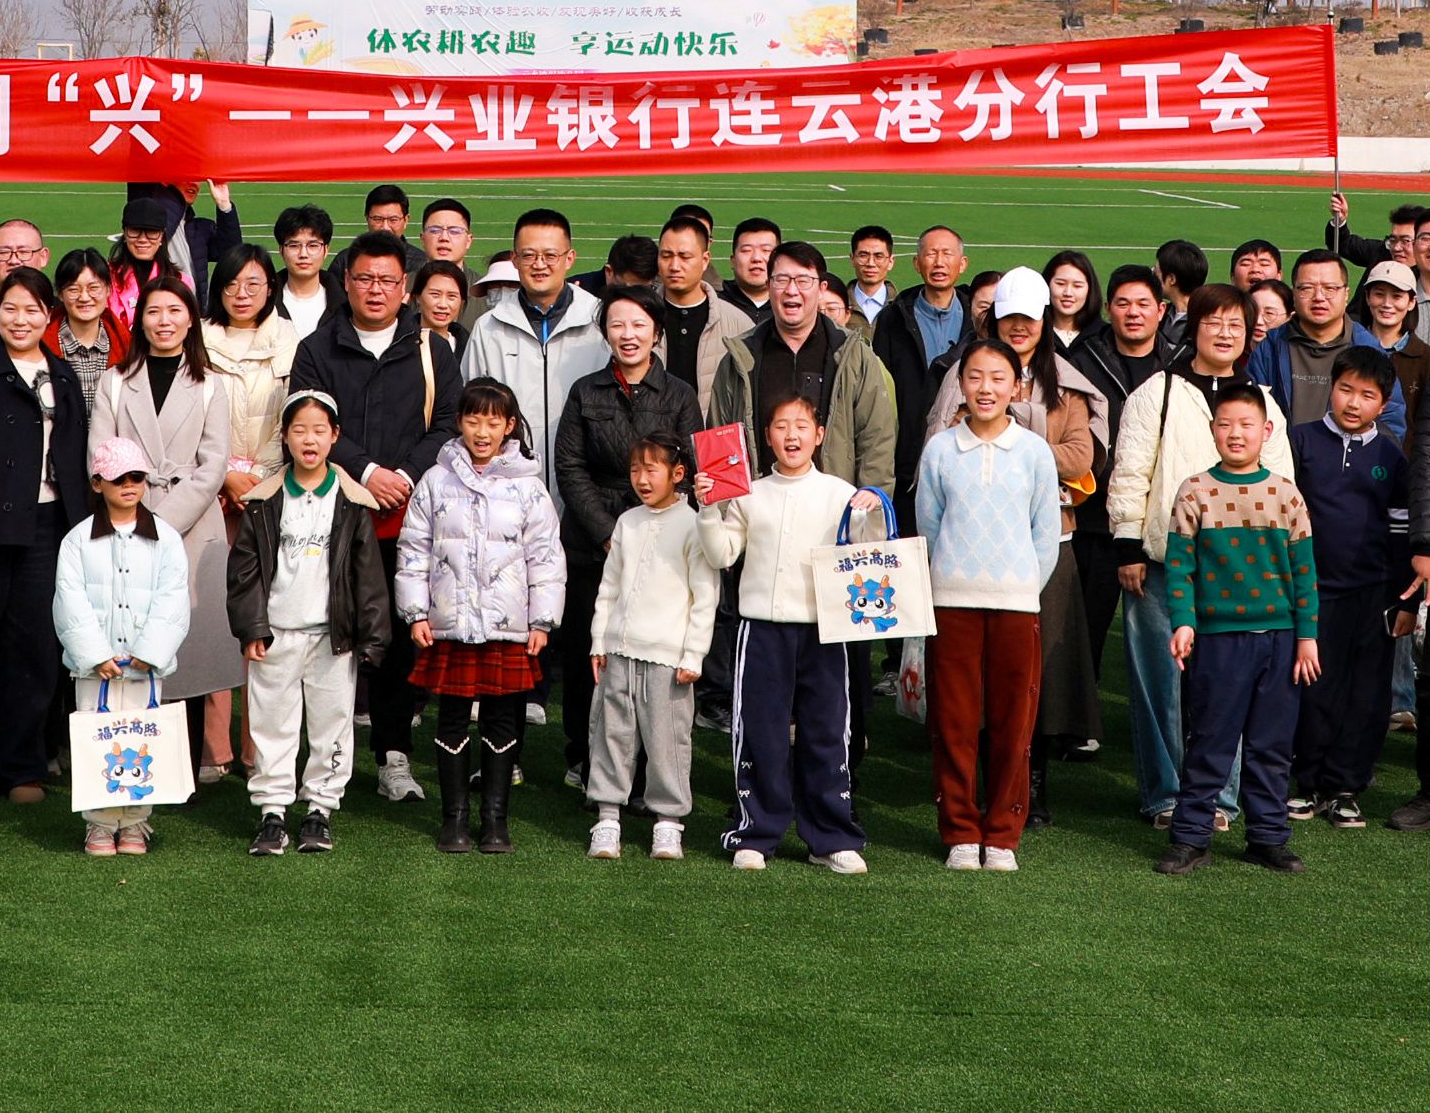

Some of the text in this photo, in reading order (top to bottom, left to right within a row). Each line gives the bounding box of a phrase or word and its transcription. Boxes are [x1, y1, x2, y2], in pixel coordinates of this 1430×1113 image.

[572, 30, 738, 56] 享运动快乐
[835, 548, 901, 572] 福兴高照
[93, 717, 160, 741] 福兴高照
